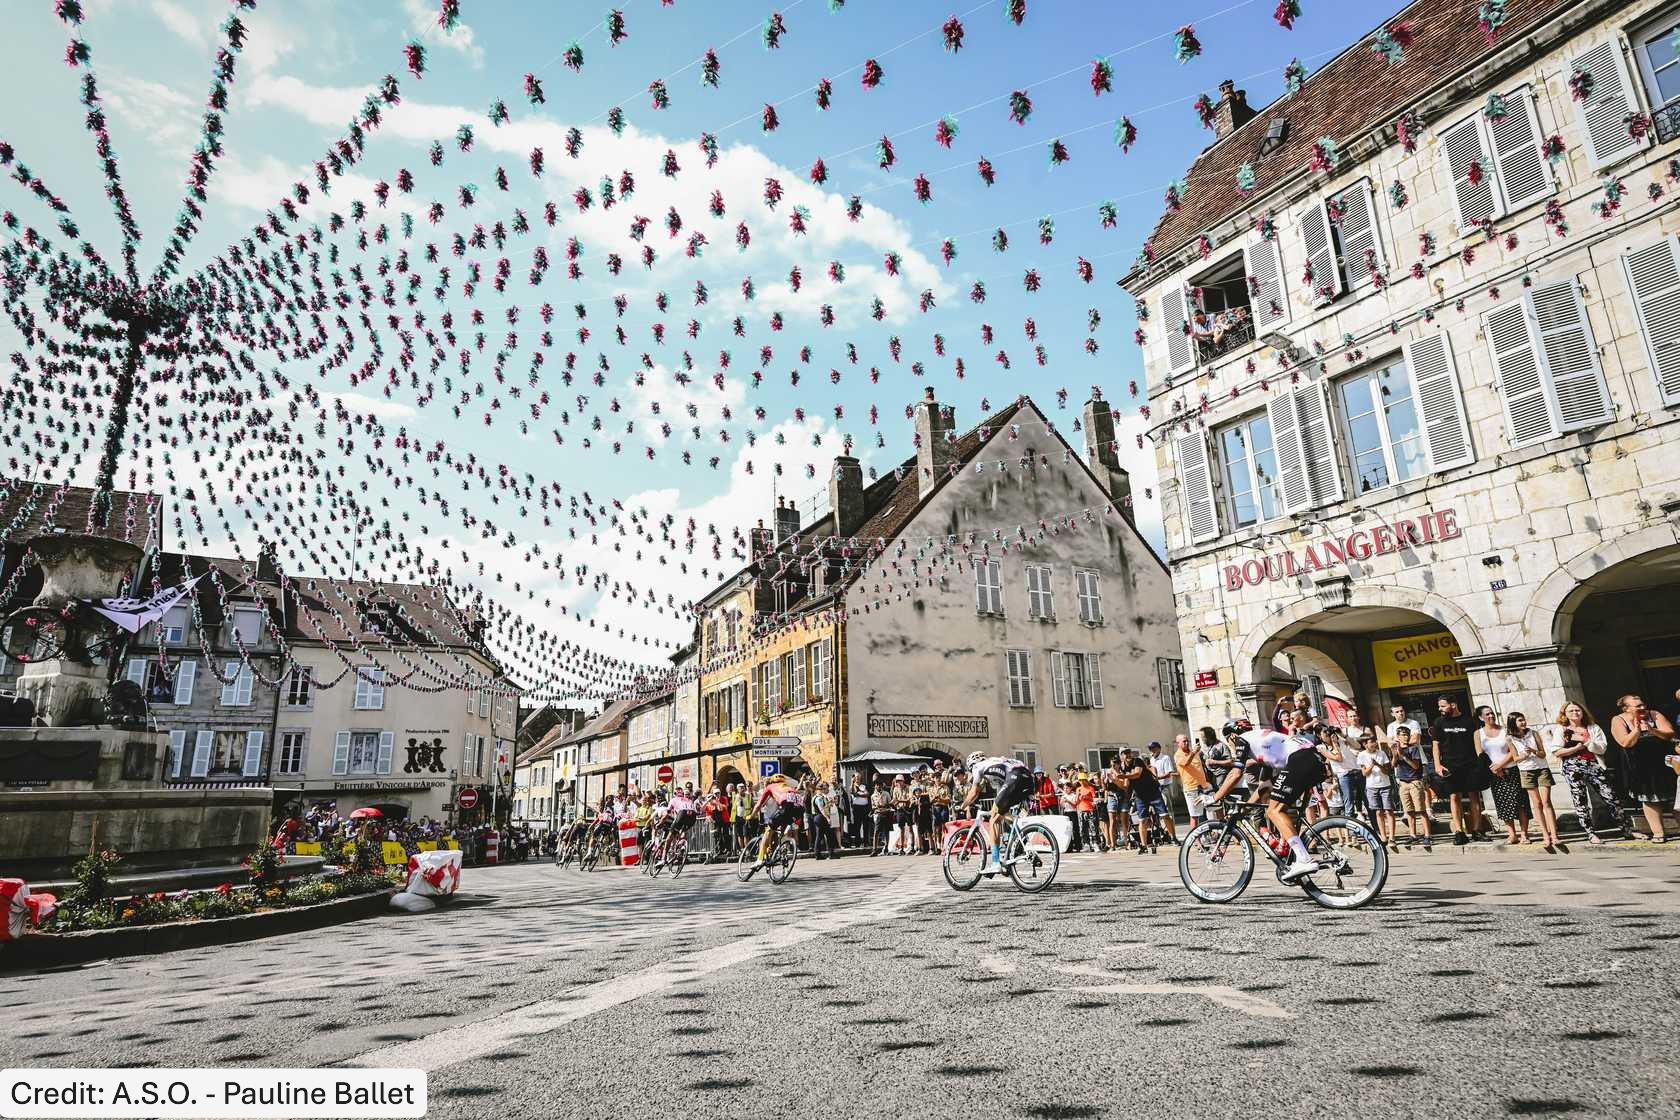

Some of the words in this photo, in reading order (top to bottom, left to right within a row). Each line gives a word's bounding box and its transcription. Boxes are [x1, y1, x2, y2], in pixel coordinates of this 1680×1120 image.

[1223, 508, 1461, 592] BOULANGERIE
[871, 718, 934, 733] PATISSERIE
[765, 764, 774, 776] P
[1272, 773, 1287, 790] UAE
